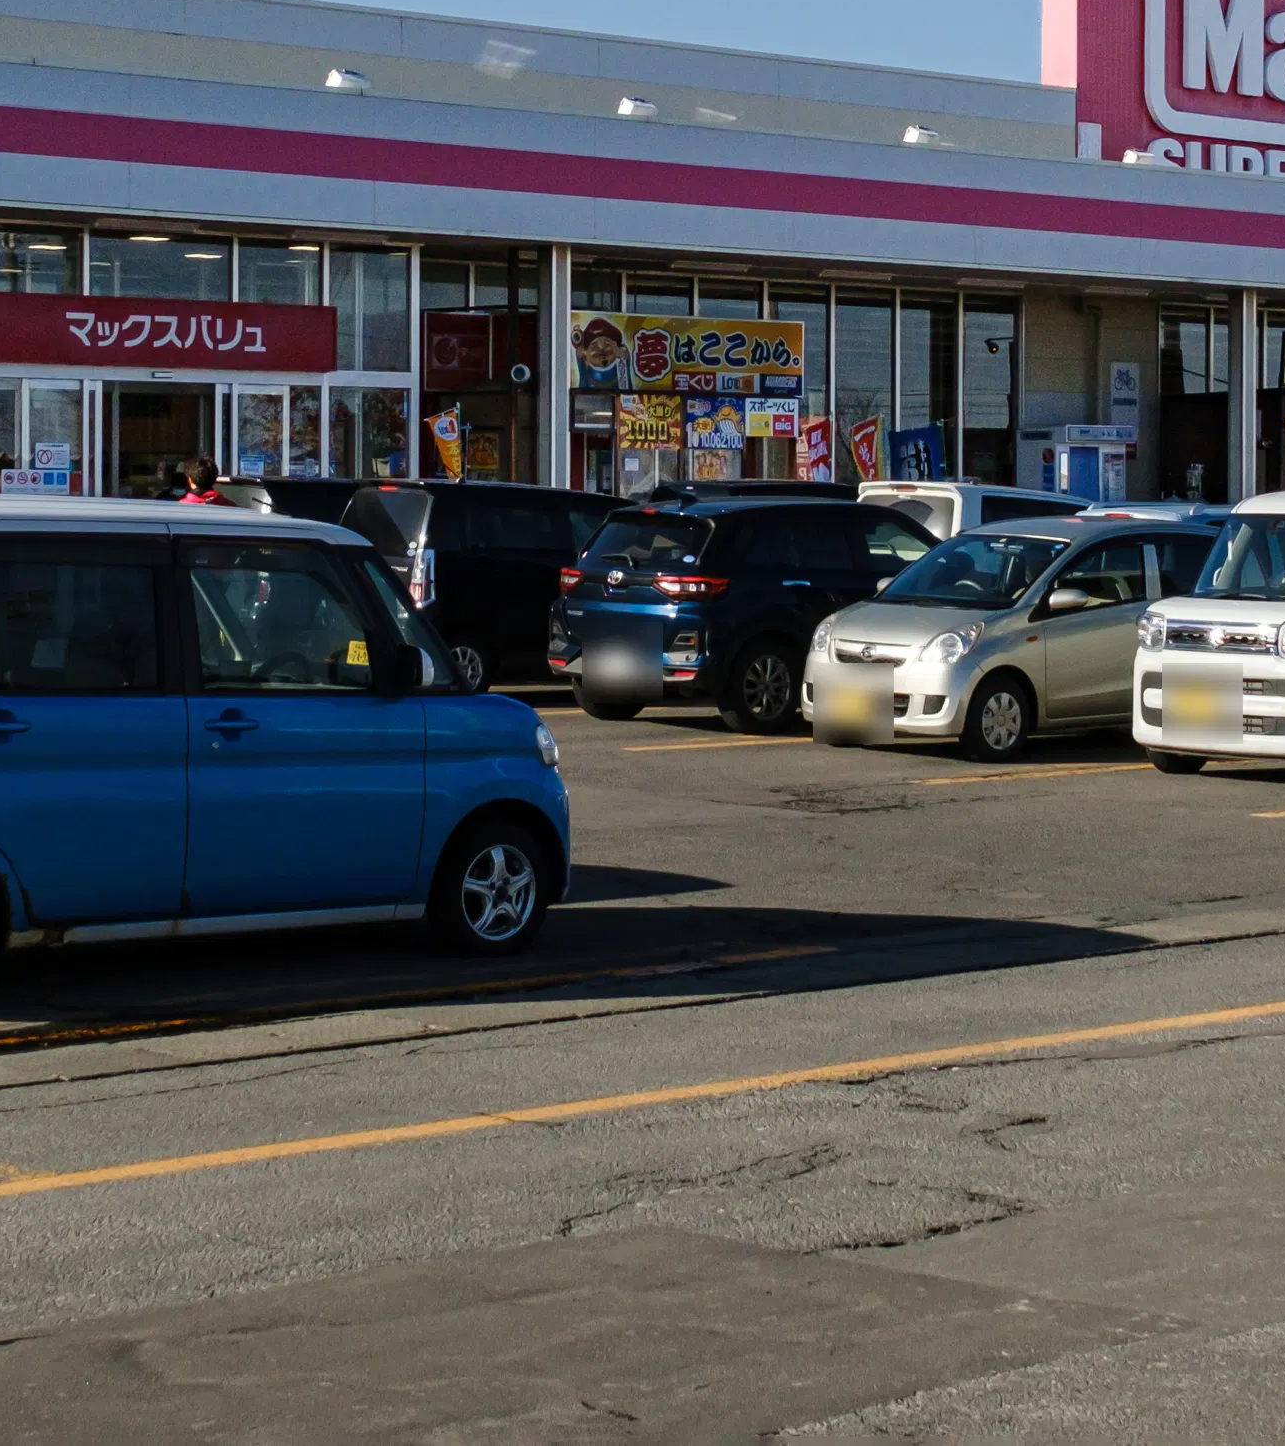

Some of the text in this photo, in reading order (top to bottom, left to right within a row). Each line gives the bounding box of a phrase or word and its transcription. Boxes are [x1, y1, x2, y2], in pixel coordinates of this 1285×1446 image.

[65, 311, 267, 352] マックスバリュ
[749, 398, 796, 412] スポーツくじ
